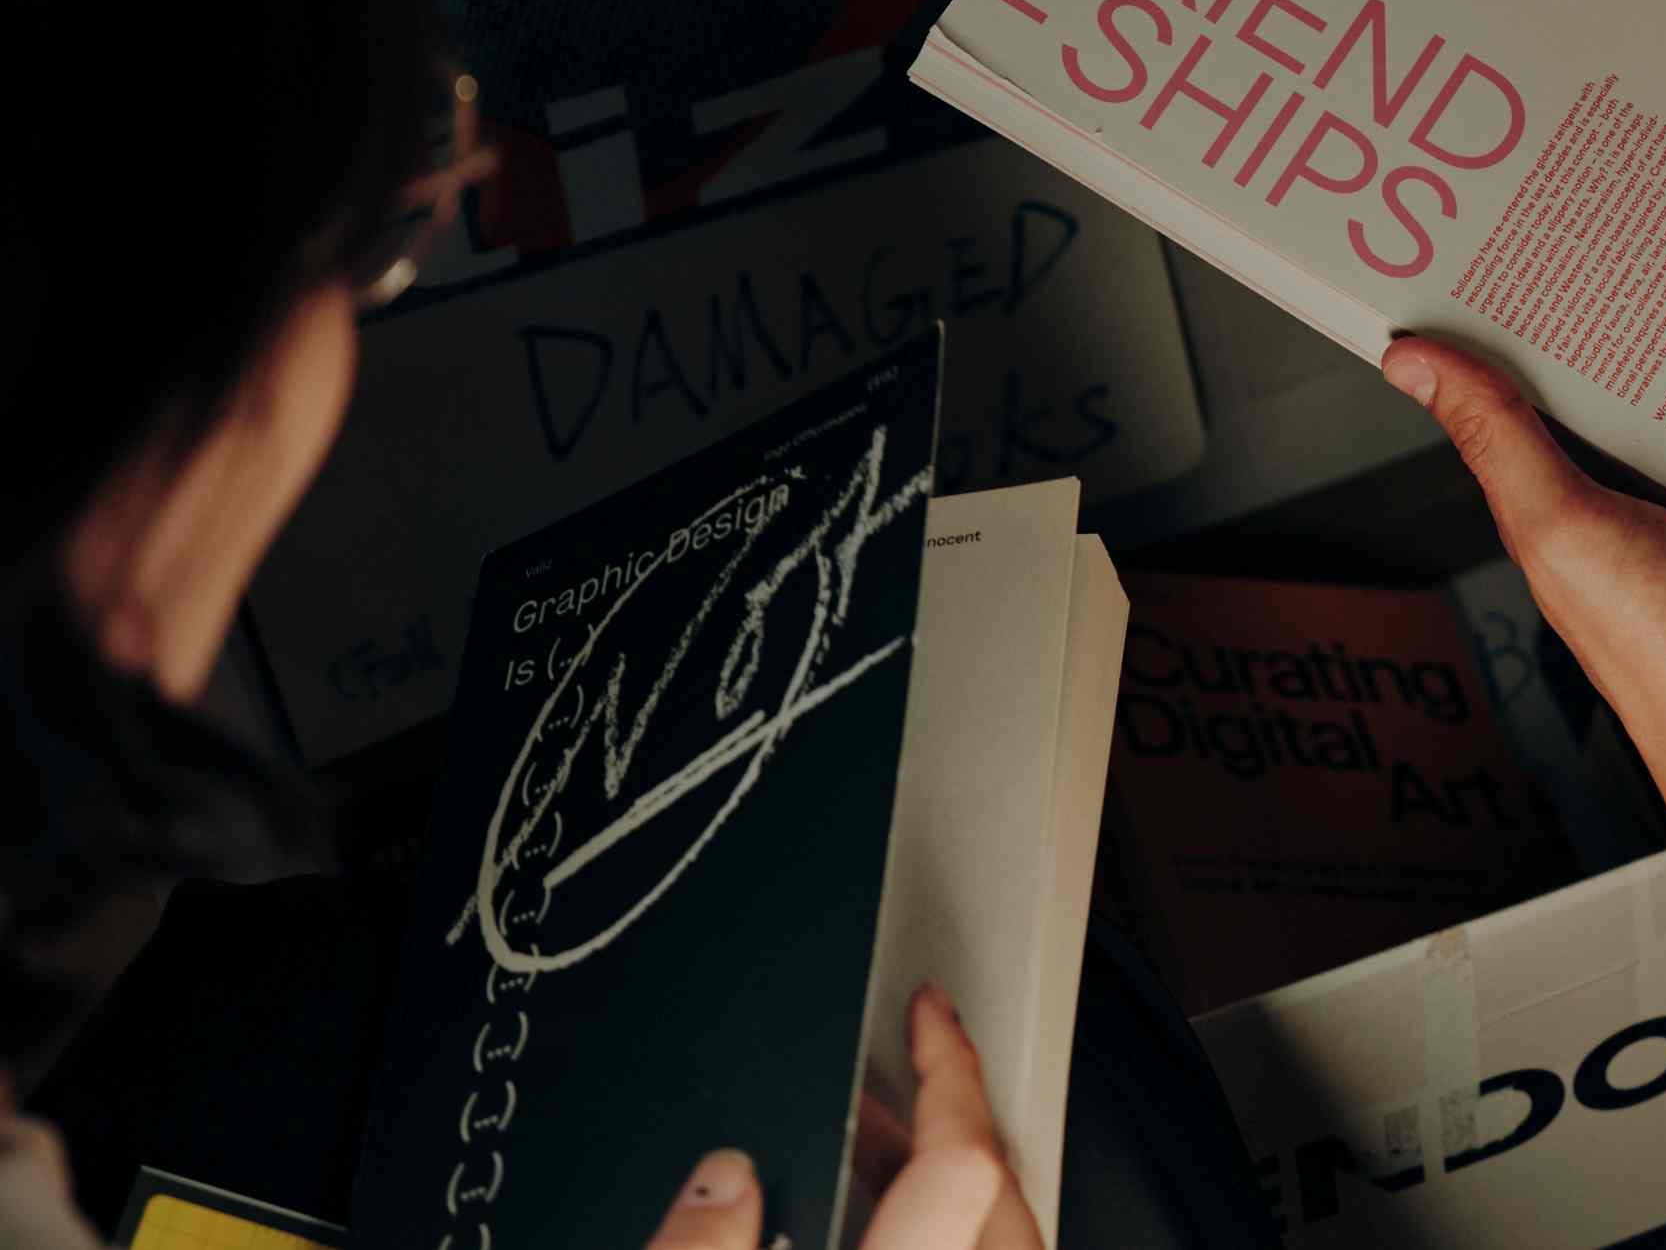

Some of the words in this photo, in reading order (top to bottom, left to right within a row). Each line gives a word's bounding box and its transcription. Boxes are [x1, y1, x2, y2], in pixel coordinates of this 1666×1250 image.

[1449, 253, 1485, 299] Solidarity
[1478, 236, 1496, 254] has
[1492, 183, 1529, 237] re-entered
[1523, 168, 1539, 186] the
[1535, 138, 1558, 170] global
[1553, 100, 1583, 142] zeitgeist
[1578, 81, 1595, 102] with
[1464, 253, 1503, 307] resounding
[1496, 228, 1518, 254] force
[1512, 218, 1525, 229] in
[1519, 200, 1536, 218] the
[1530, 182, 1547, 202] last
[1543, 144, 1572, 183] decades
[1568, 124, 1584, 145] and
[1578, 116, 1590, 127] is
[1586, 72, 1619, 118] especially
[1477, 281, 1502, 314] urgent
[1496, 270, 1509, 282] to
[1505, 229, 1534, 271] consider
[1546, 183, 1564, 199] Yet
[1558, 165, 1575, 184] this
[1571, 128, 1600, 166] concept
[1598, 97, 1619, 121] both
[516, 202, 1078, 460] DAMAGED
[511, 548, 657, 635] Graphic
[664, 481, 793, 563] Design
[926, 530, 982, 548] nocent
[504, 656, 536, 692] Is
[1120, 693, 1381, 780] Digital
[1126, 623, 1470, 725] Curating
[1391, 761, 1513, 824] Art
